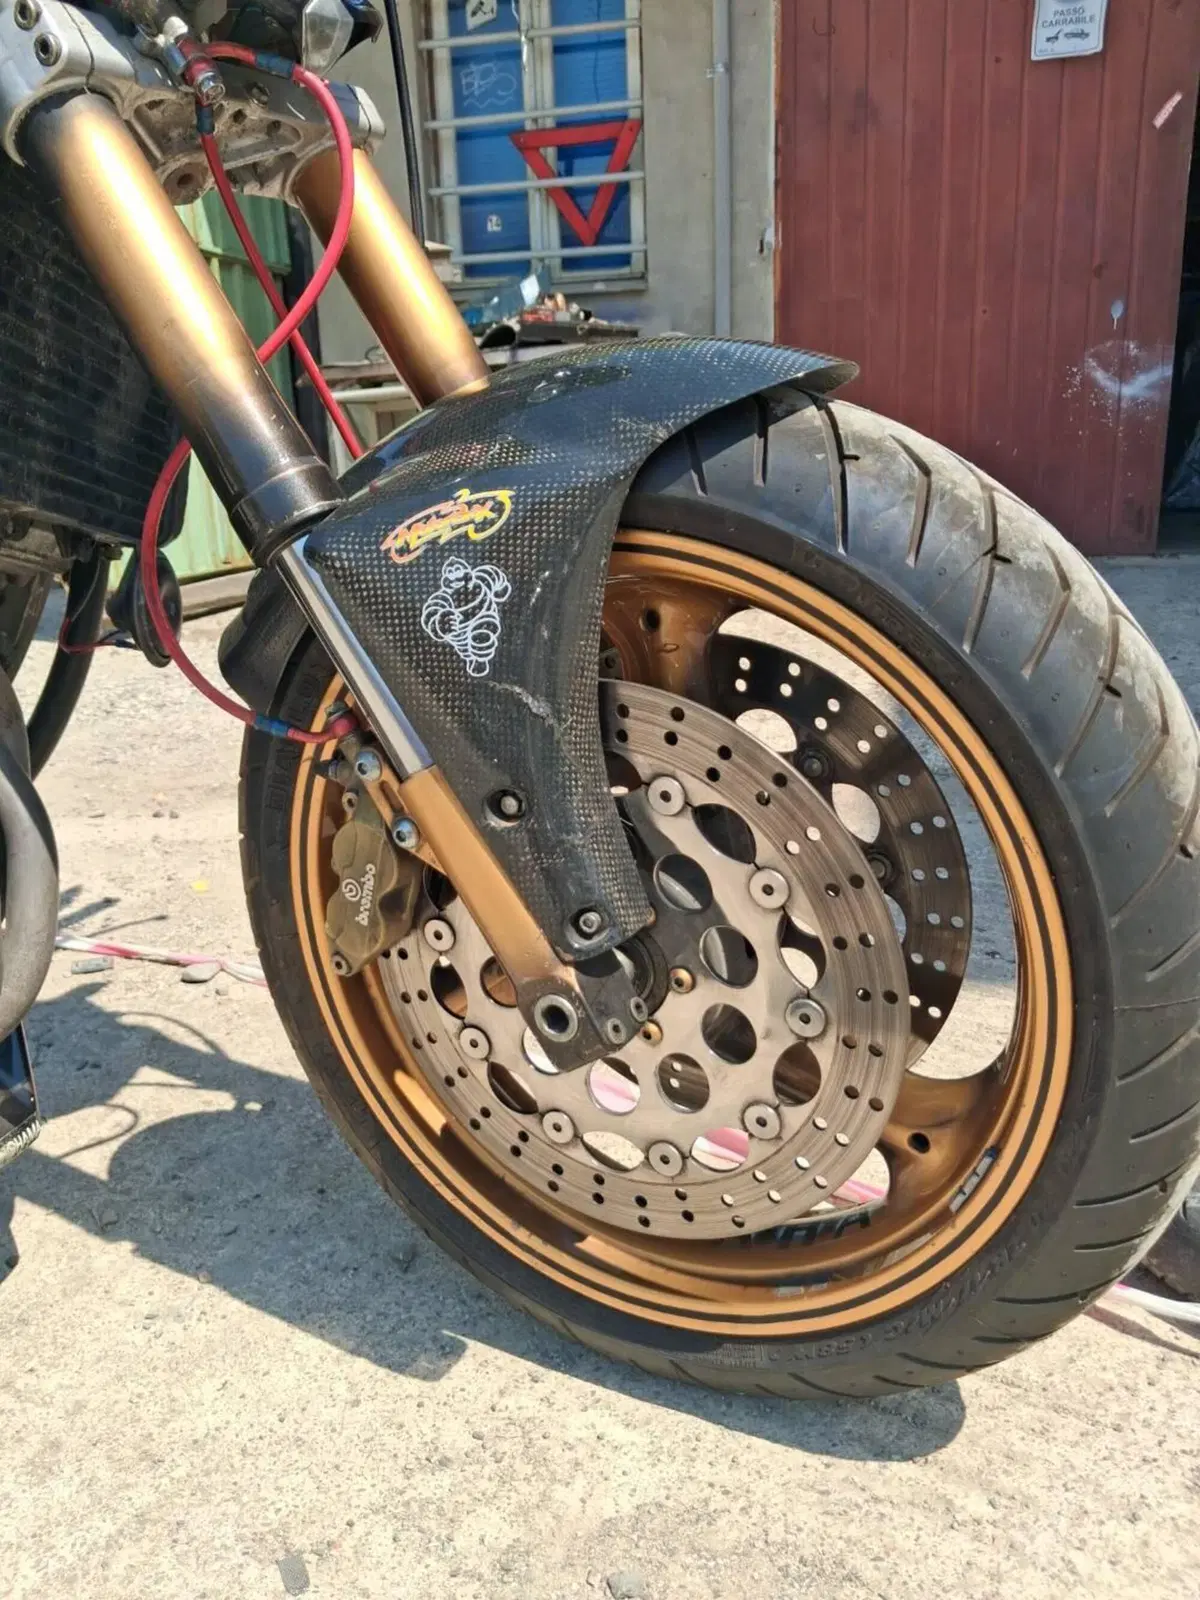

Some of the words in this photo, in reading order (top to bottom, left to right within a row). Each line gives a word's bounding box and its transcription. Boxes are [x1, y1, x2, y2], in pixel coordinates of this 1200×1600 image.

[1053, 6, 1085, 18] PASSO
[1041, 14, 1096, 29] CARRABILE
[354, 863, 376, 927] brembo
